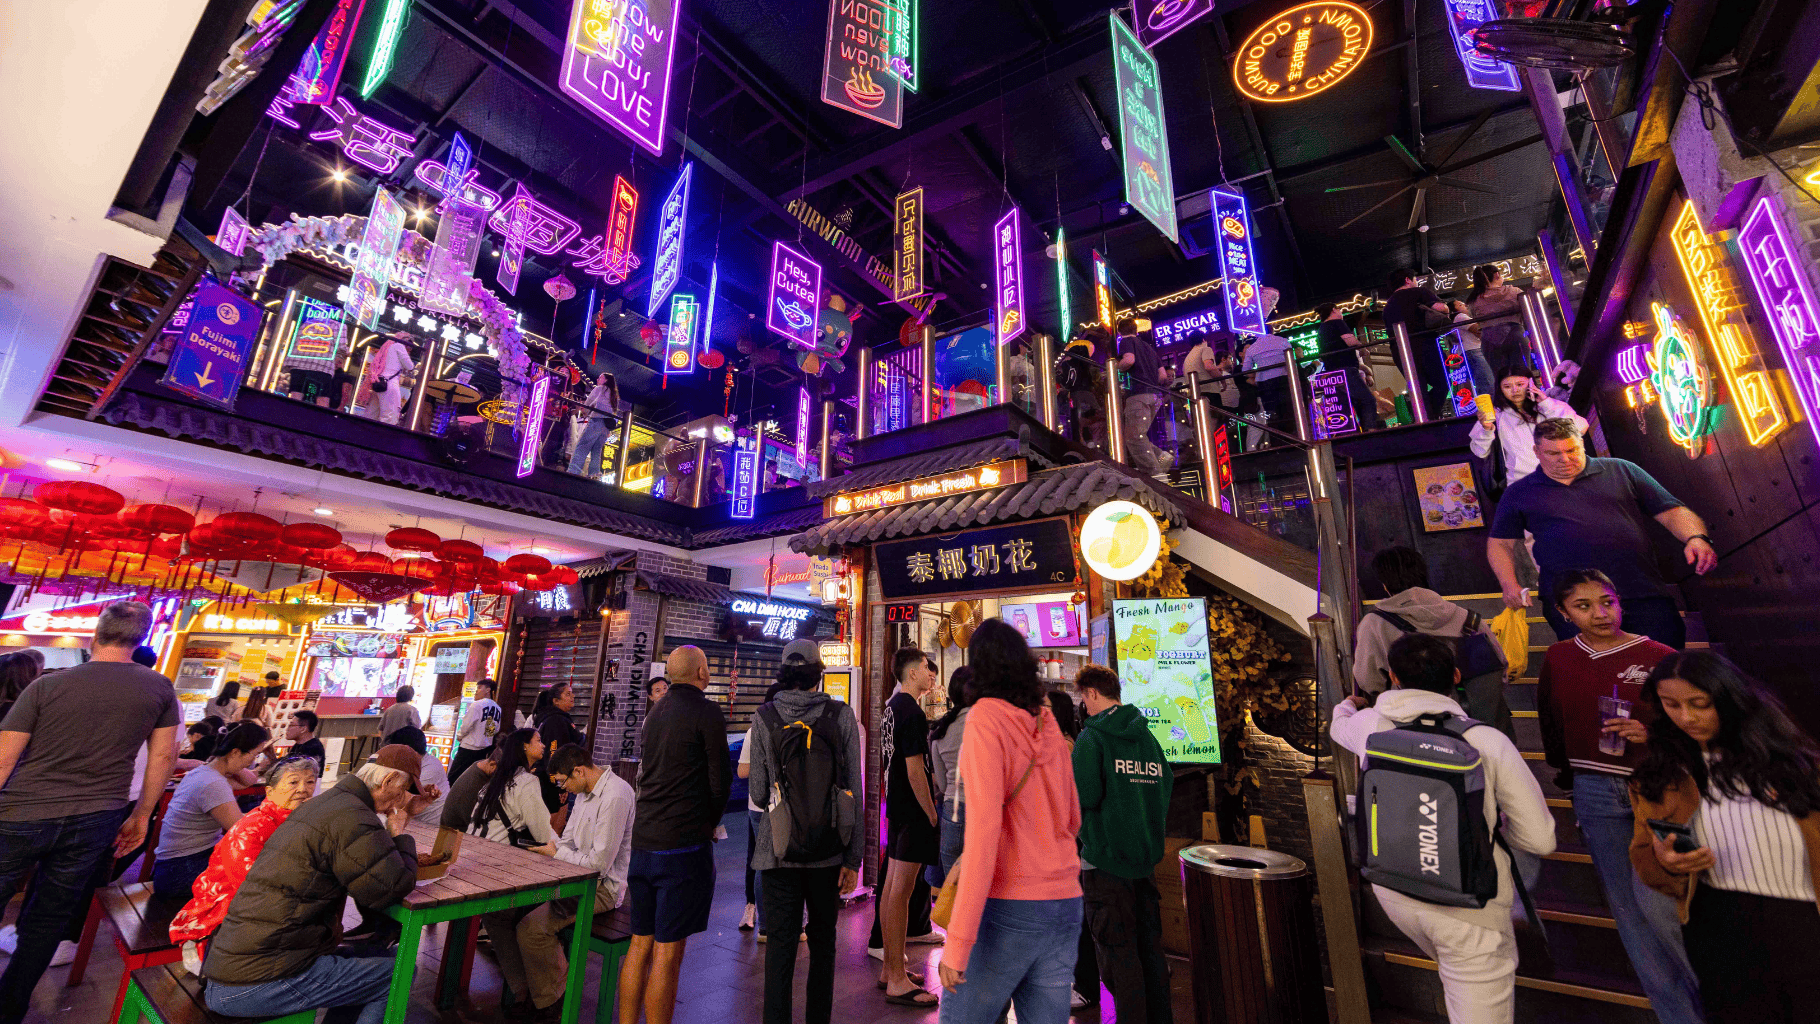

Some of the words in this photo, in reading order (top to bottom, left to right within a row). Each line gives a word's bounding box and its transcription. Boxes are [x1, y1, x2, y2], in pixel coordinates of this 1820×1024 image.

[1245, 21, 1292, 95] BURWOOD
[1305, 9, 1362, 90] CHINATOWN
[583, 54, 653, 128] LOVE
[783, 257, 812, 287] Hey,
[776, 272, 816, 304] Cutea
[1173, 311, 1218, 333] SUGAR
[189, 332, 242, 364] Dorayaki
[201, 326, 237, 349] Fujimi
[738, 456, 751, 513] 我站C位
[854, 494, 881, 508] Drink
[910, 480, 941, 498] Drink
[813, 563, 829, 571] Inada
[906, 538, 1038, 584] 泰椰奶花
[763, 564, 813, 593] Burwood
[1050, 570, 1066, 583] 4C
[732, 600, 757, 614] CHA
[757, 603, 778, 616] DIM
[777, 606, 810, 621] HOUSE
[887, 606, 914, 622] 072
[1116, 606, 1150, 619] Fresh
[1155, 601, 1194, 615] Mango
[633, 631, 648, 666] CHA
[1156, 649, 1206, 659] YOGHURT
[627, 669, 643, 701] DIM
[621, 703, 640, 757] HOUSE
[1183, 744, 1217, 756] lemon
[1432, 744, 1454, 755] YONEX
[1418, 824, 1440, 876] YONEX
